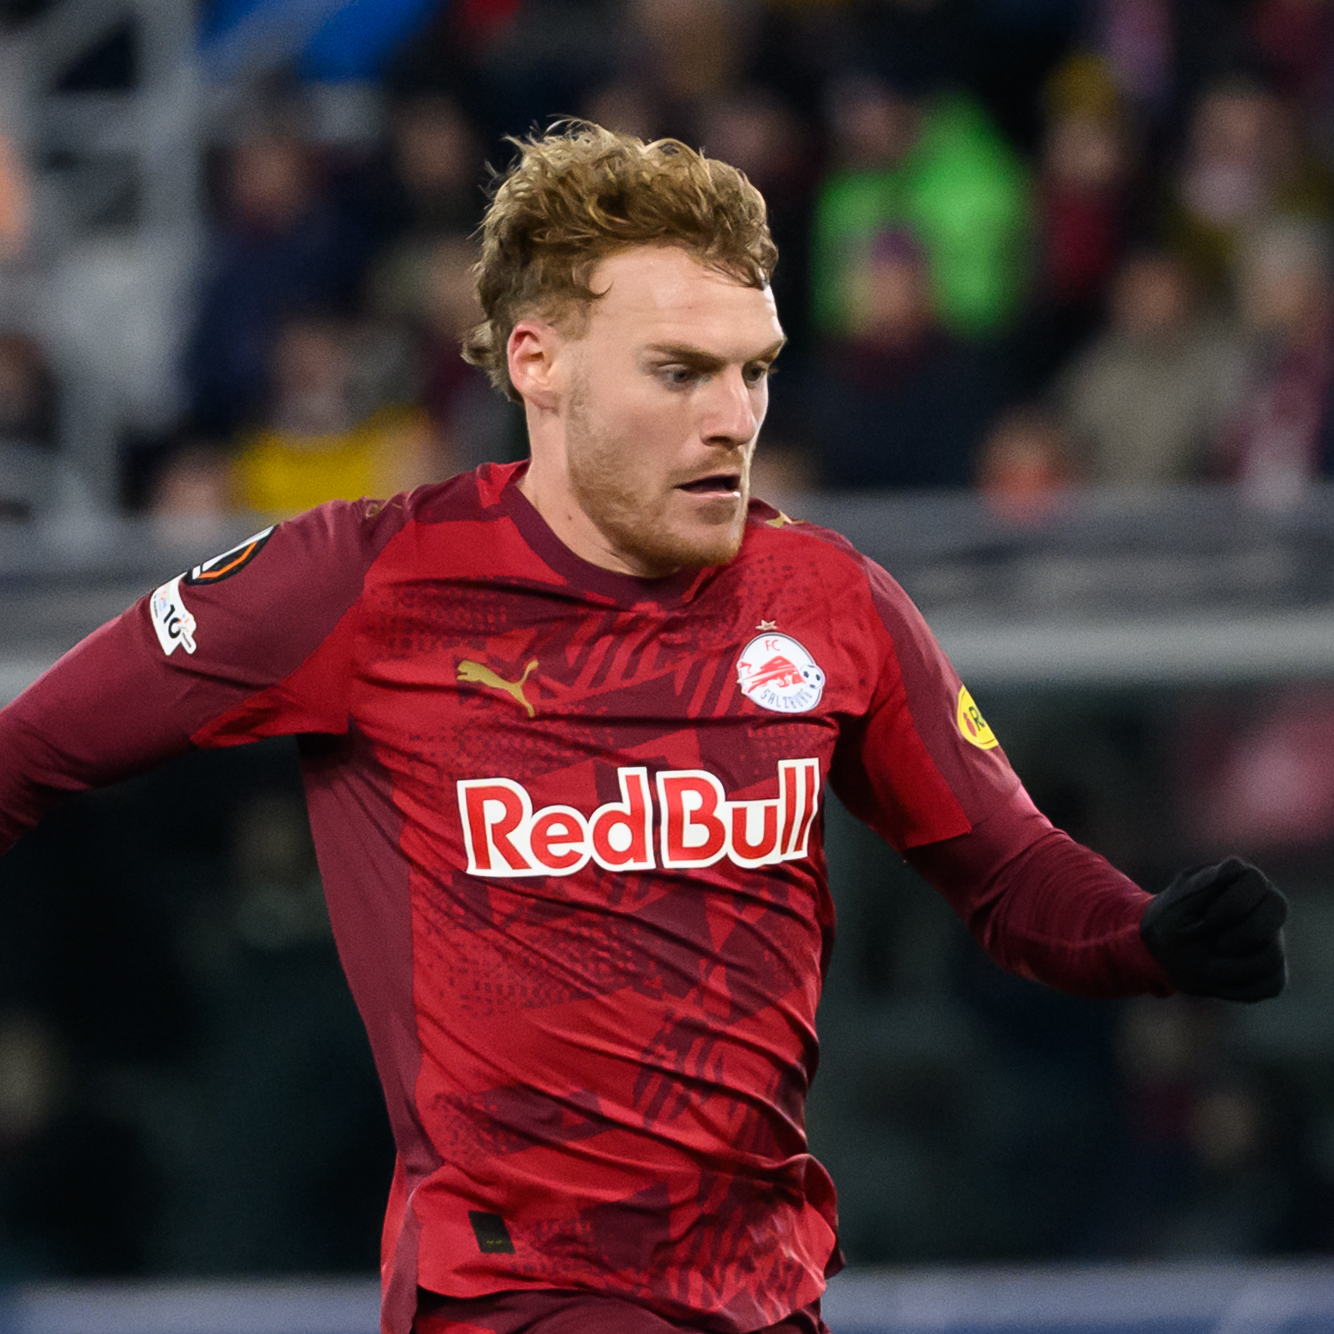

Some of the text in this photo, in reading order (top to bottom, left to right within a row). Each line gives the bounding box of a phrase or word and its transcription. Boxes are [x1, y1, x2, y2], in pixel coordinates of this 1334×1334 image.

[765, 639, 781, 652] FC
[459, 759, 818, 874] Red Bull
